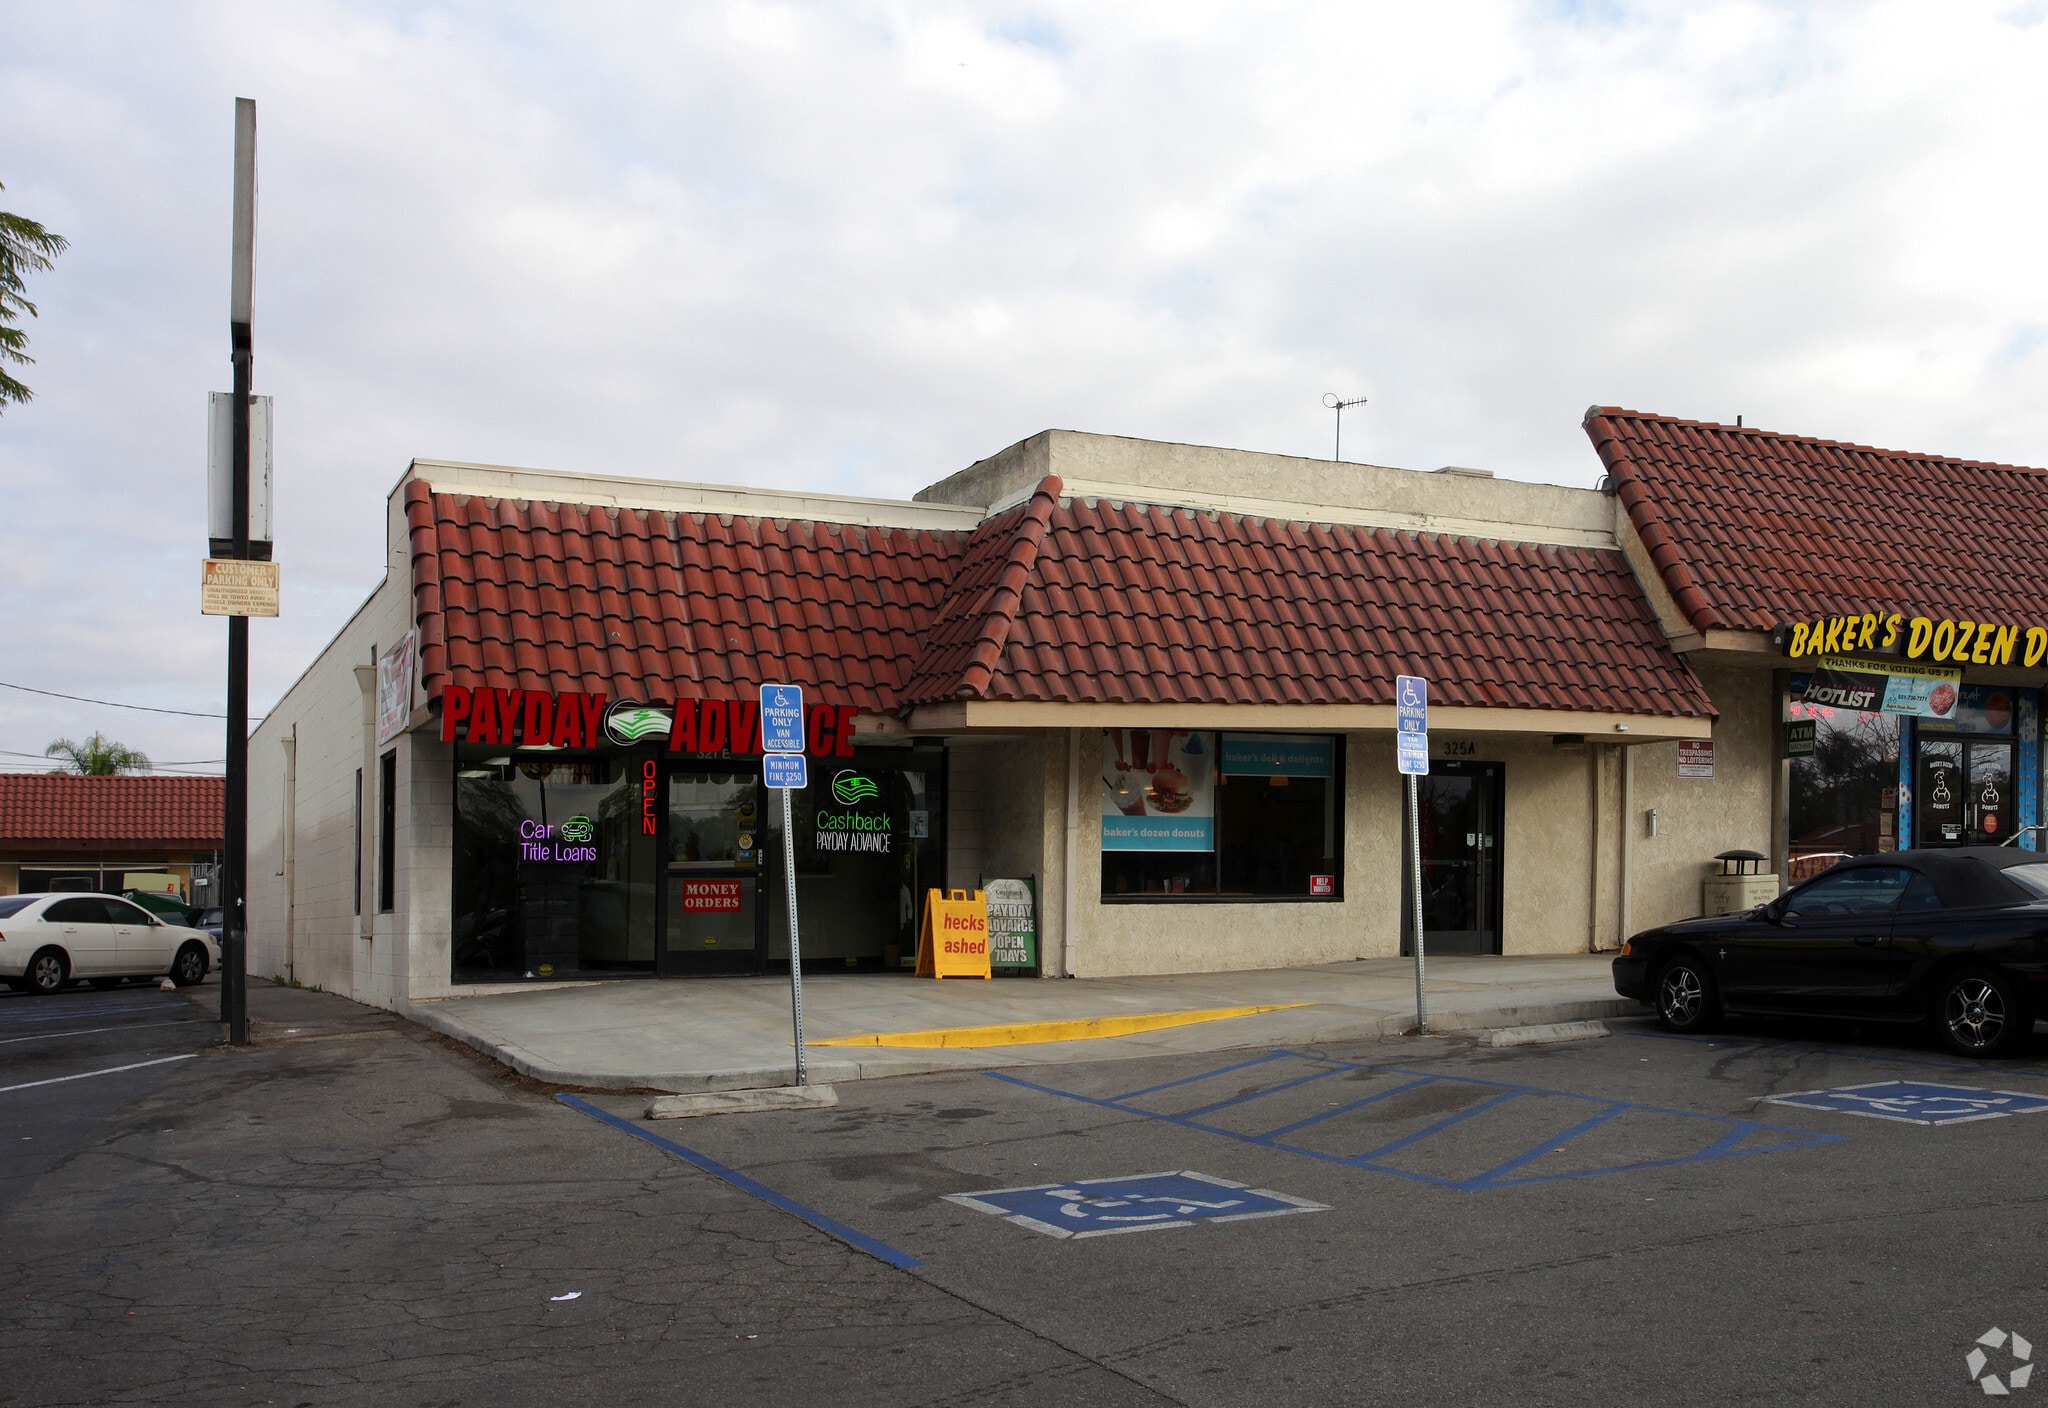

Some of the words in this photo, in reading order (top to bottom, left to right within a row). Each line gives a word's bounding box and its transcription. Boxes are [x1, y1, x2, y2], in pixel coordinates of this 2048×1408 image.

[216, 564, 266, 576] CUSTOMER
[207, 574, 248, 586] PARKING
[251, 576, 274, 587] ONLY
[1790, 610, 1900, 658] BAKER'S
[1907, 617, 2018, 666] DOZEN
[1826, 657, 1865, 669] THANKS
[1868, 662, 1888, 671] FOR
[1890, 664, 1925, 676] VOTING
[1928, 668, 1942, 676] US
[1944, 670, 1954, 678] #1
[1804, 684, 1875, 708] HOTLIST
[441, 685, 608, 748] PAYDAY
[765, 708, 799, 717] PARKING
[1400, 706, 1424, 719] PARKING
[772, 718, 792, 726] ONLY
[1404, 720, 1420, 731] ONLY
[776, 729, 790, 738] VAN
[1790, 726, 1813, 740] ATM
[768, 739, 800, 748] ACCESSIBLE
[1444, 742, 1475, 755] 325A
[1790, 742, 1813, 750] MACHINE
[1226, 752, 1258, 762] baker's
[1260, 753, 1277, 762] deli
[1288, 754, 1324, 764] delights
[1401, 760, 1412, 768] FINE
[1414, 760, 1425, 768] $250
[518, 762, 591, 773] WESTERN
[770, 761, 799, 770] MINIMUM
[769, 772, 783, 780] FINE
[786, 772, 802, 782] $250
[642, 760, 656, 836] OPEN
[817, 810, 890, 830] Cashback
[520, 820, 554, 839] Car
[1104, 827, 1138, 836] baker's
[1140, 828, 1170, 837] dozen
[1172, 828, 1205, 837] donuts
[816, 831, 848, 851] PAYDAY
[850, 832, 891, 852] ADVANCE
[520, 842, 550, 860] Title
[556, 842, 597, 861] Loans
[1792, 856, 1840, 878] ATM
[1316, 878, 1328, 886] HELP
[686, 884, 739, 895] MONEY
[685, 898, 739, 908] ORDERS
[1714, 896, 1730, 904] CITY
[987, 904, 1032, 917] PAYDAY
[944, 913, 985, 931] hecks
[988, 919, 1033, 932] ADVANCE
[944, 938, 986, 954] ashed
[997, 936, 1024, 948] OPEN
